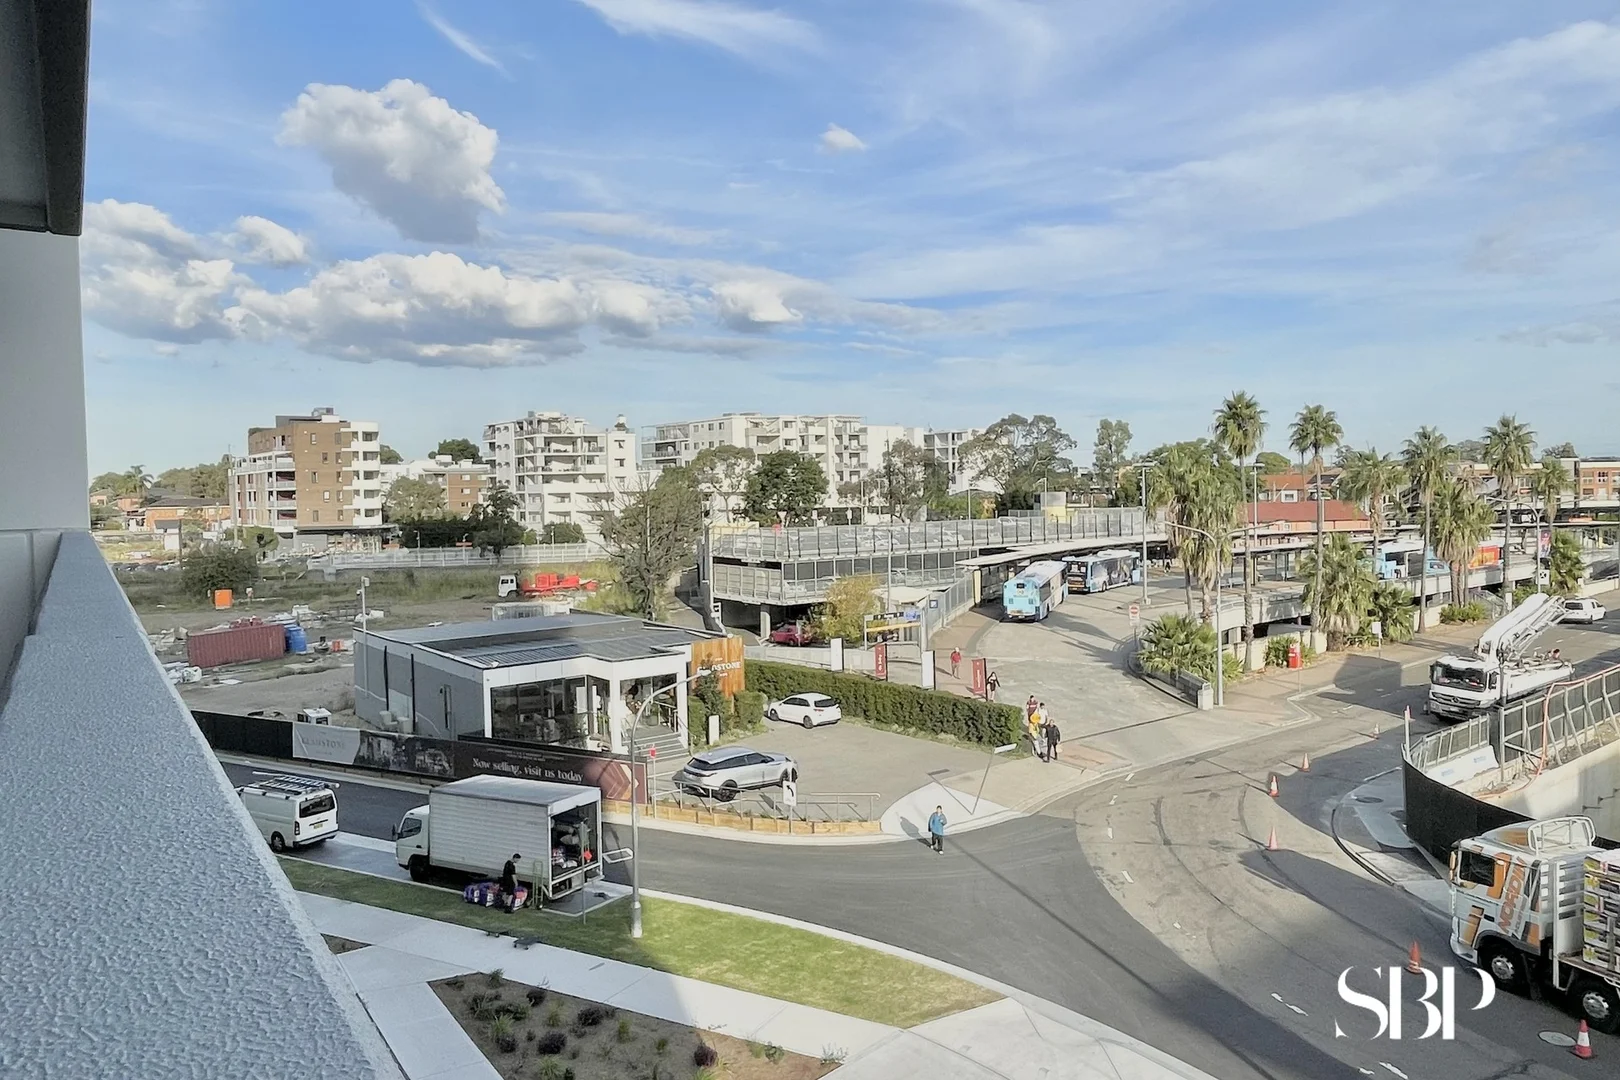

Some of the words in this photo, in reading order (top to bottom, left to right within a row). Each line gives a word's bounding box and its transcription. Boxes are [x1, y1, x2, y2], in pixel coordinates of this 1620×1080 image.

[473, 758, 491, 769] Now
[493, 761, 522, 776] selling,
[524, 764, 542, 776] visit
[544, 769, 555, 778] us
[558, 770, 584, 784] today
